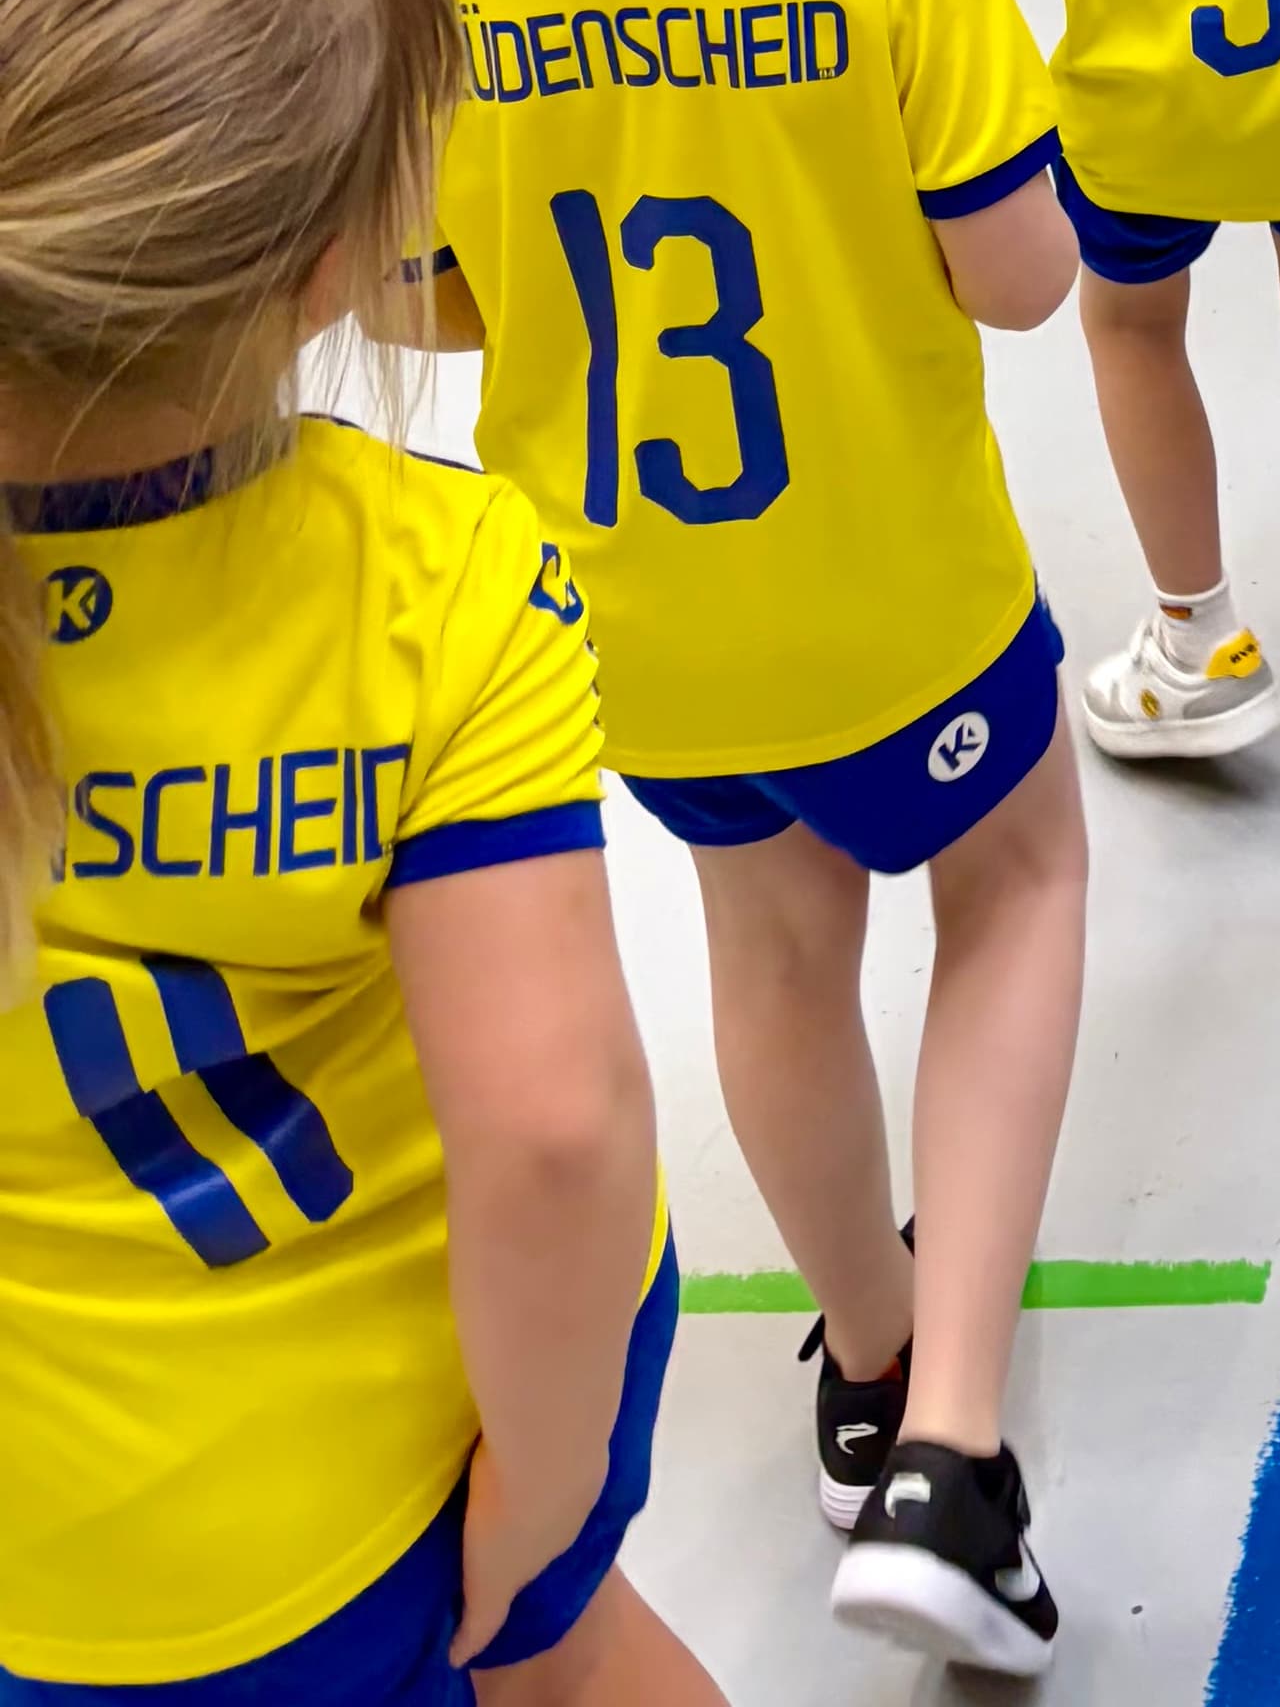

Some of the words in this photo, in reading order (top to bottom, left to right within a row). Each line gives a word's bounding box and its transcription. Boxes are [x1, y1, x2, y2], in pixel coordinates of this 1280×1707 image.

[462, 0, 850, 104] ÜDENSCHEID
[548, 188, 791, 528] 13
[42, 951, 355, 1268] 11
